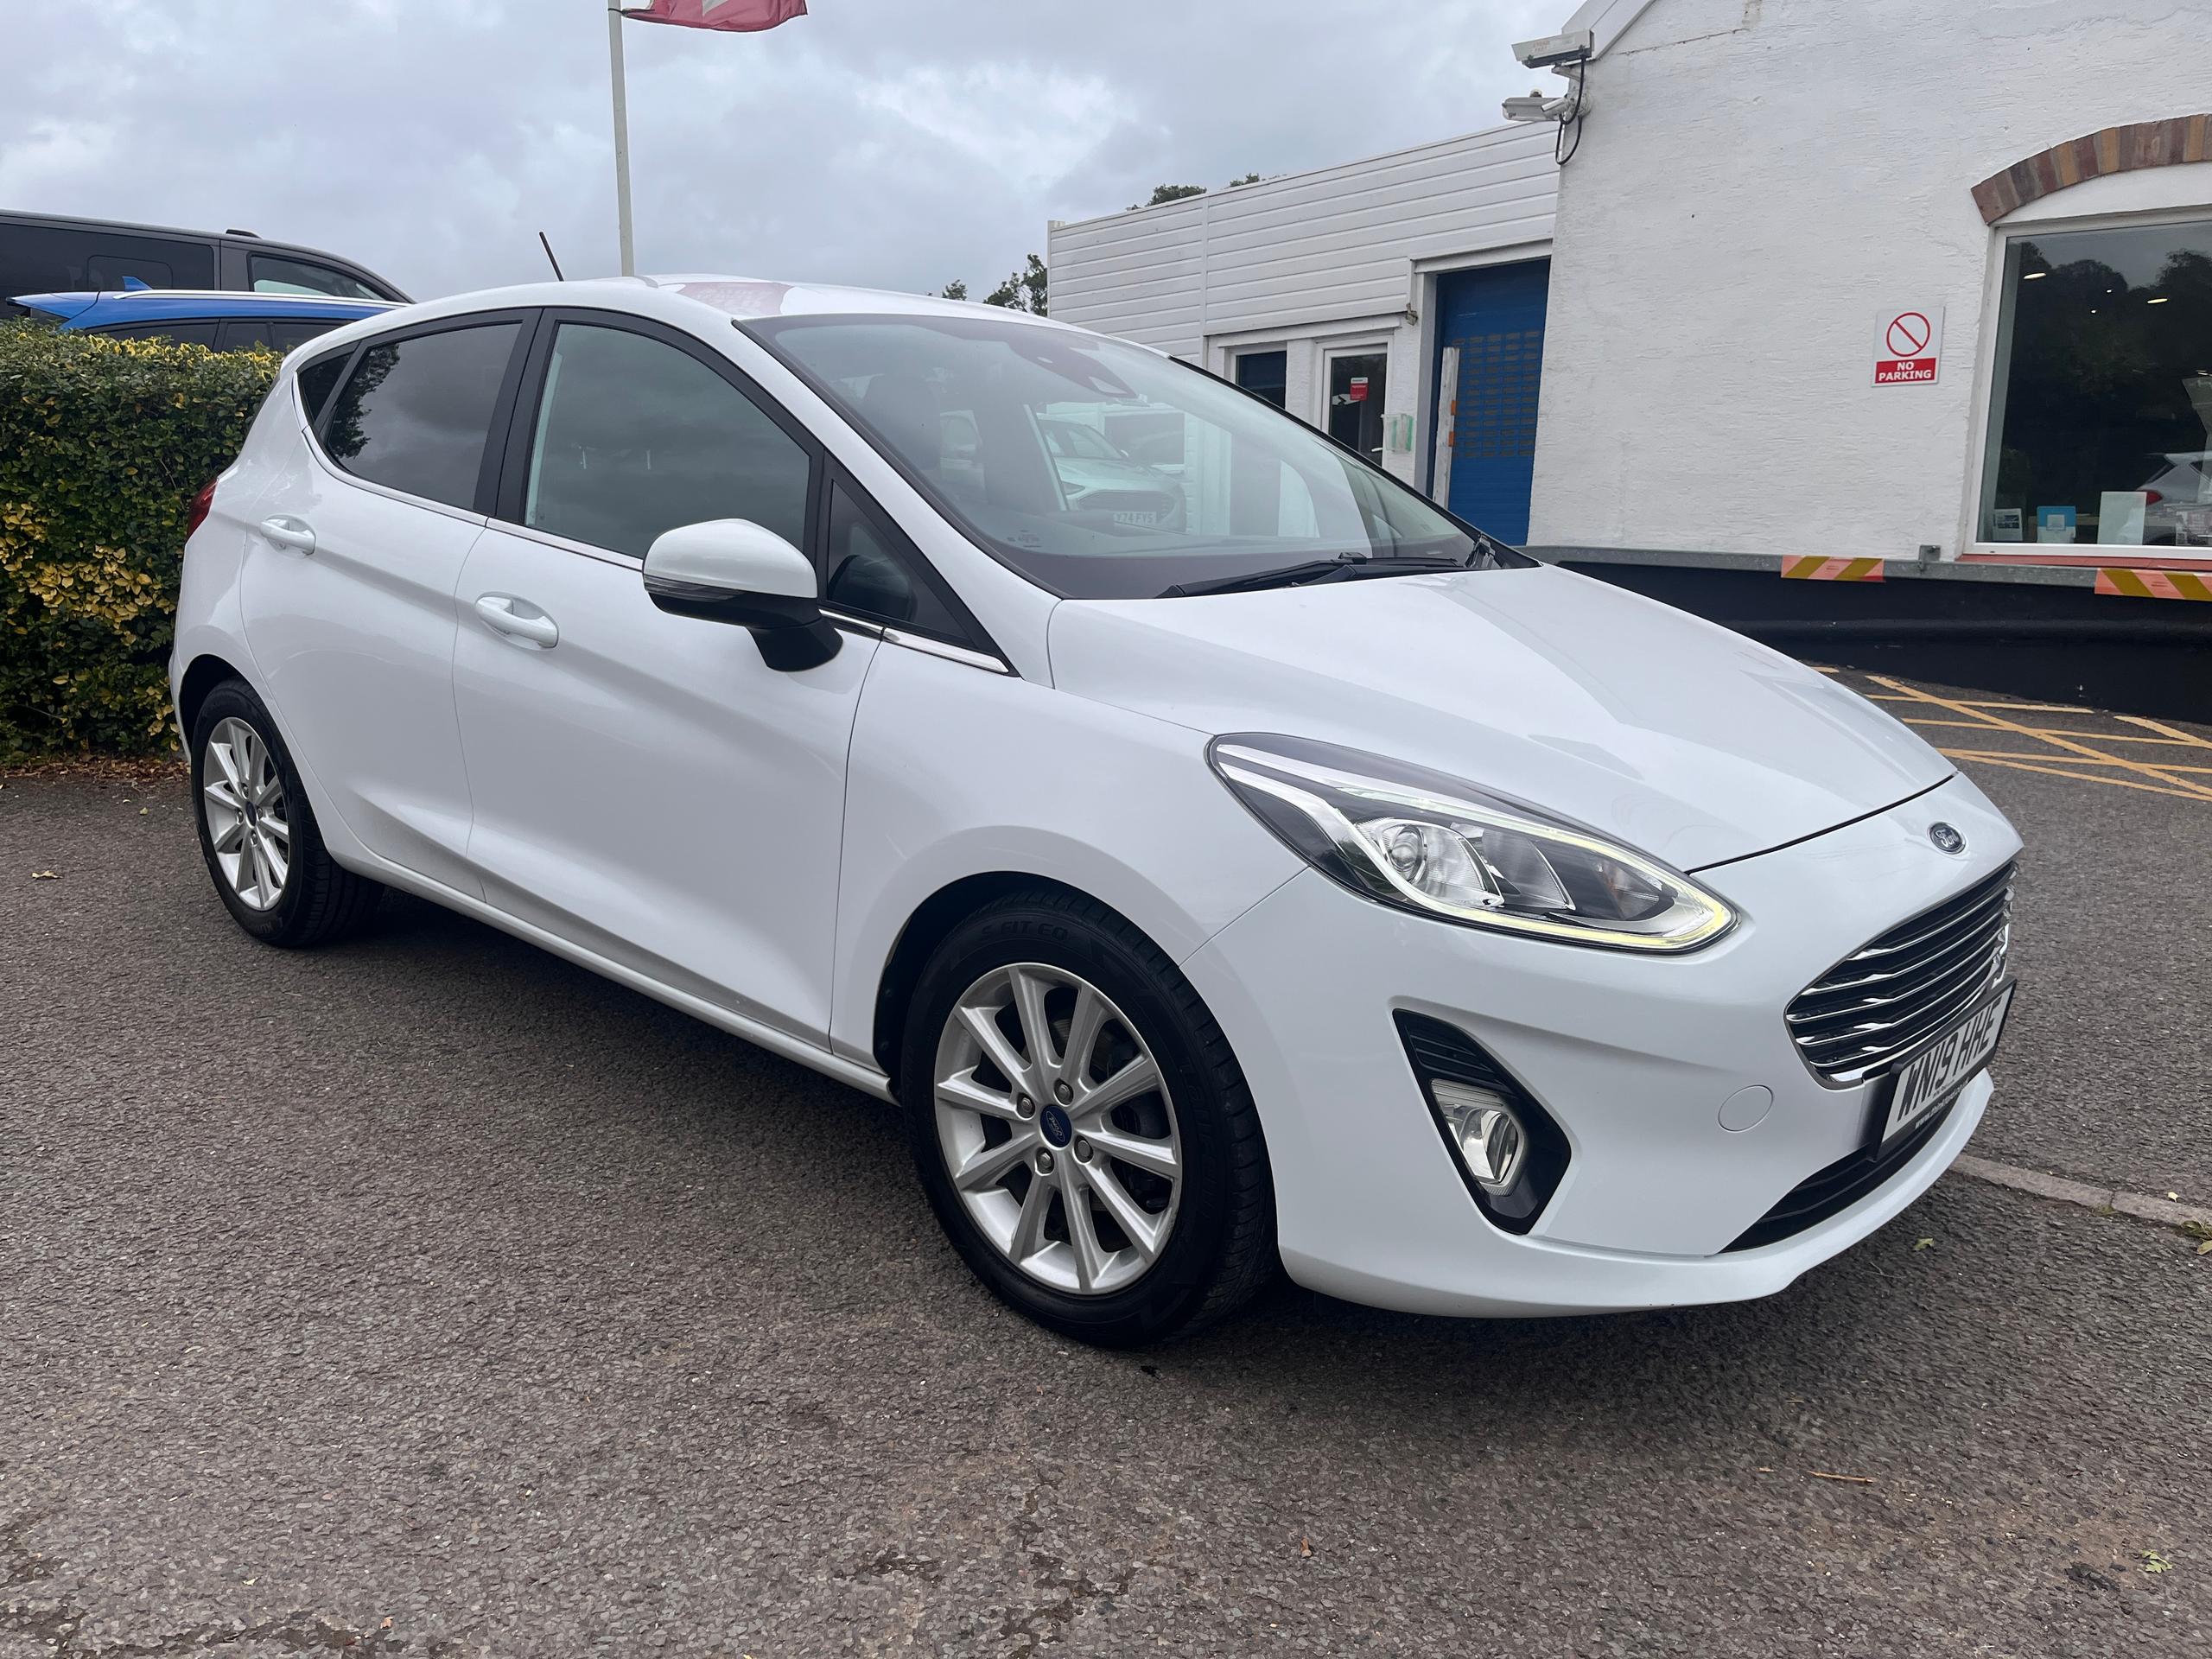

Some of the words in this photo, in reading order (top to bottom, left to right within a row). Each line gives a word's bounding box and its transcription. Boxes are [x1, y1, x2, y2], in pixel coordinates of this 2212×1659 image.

[1897, 361, 1914, 371] NO
[1878, 369, 1931, 381] PARKING
[1936, 829, 1960, 848] Ford
[1001, 920, 1033, 935] FIT
[1897, 1031, 1959, 1122] WN19
[1952, 995, 2003, 1077] HHE
